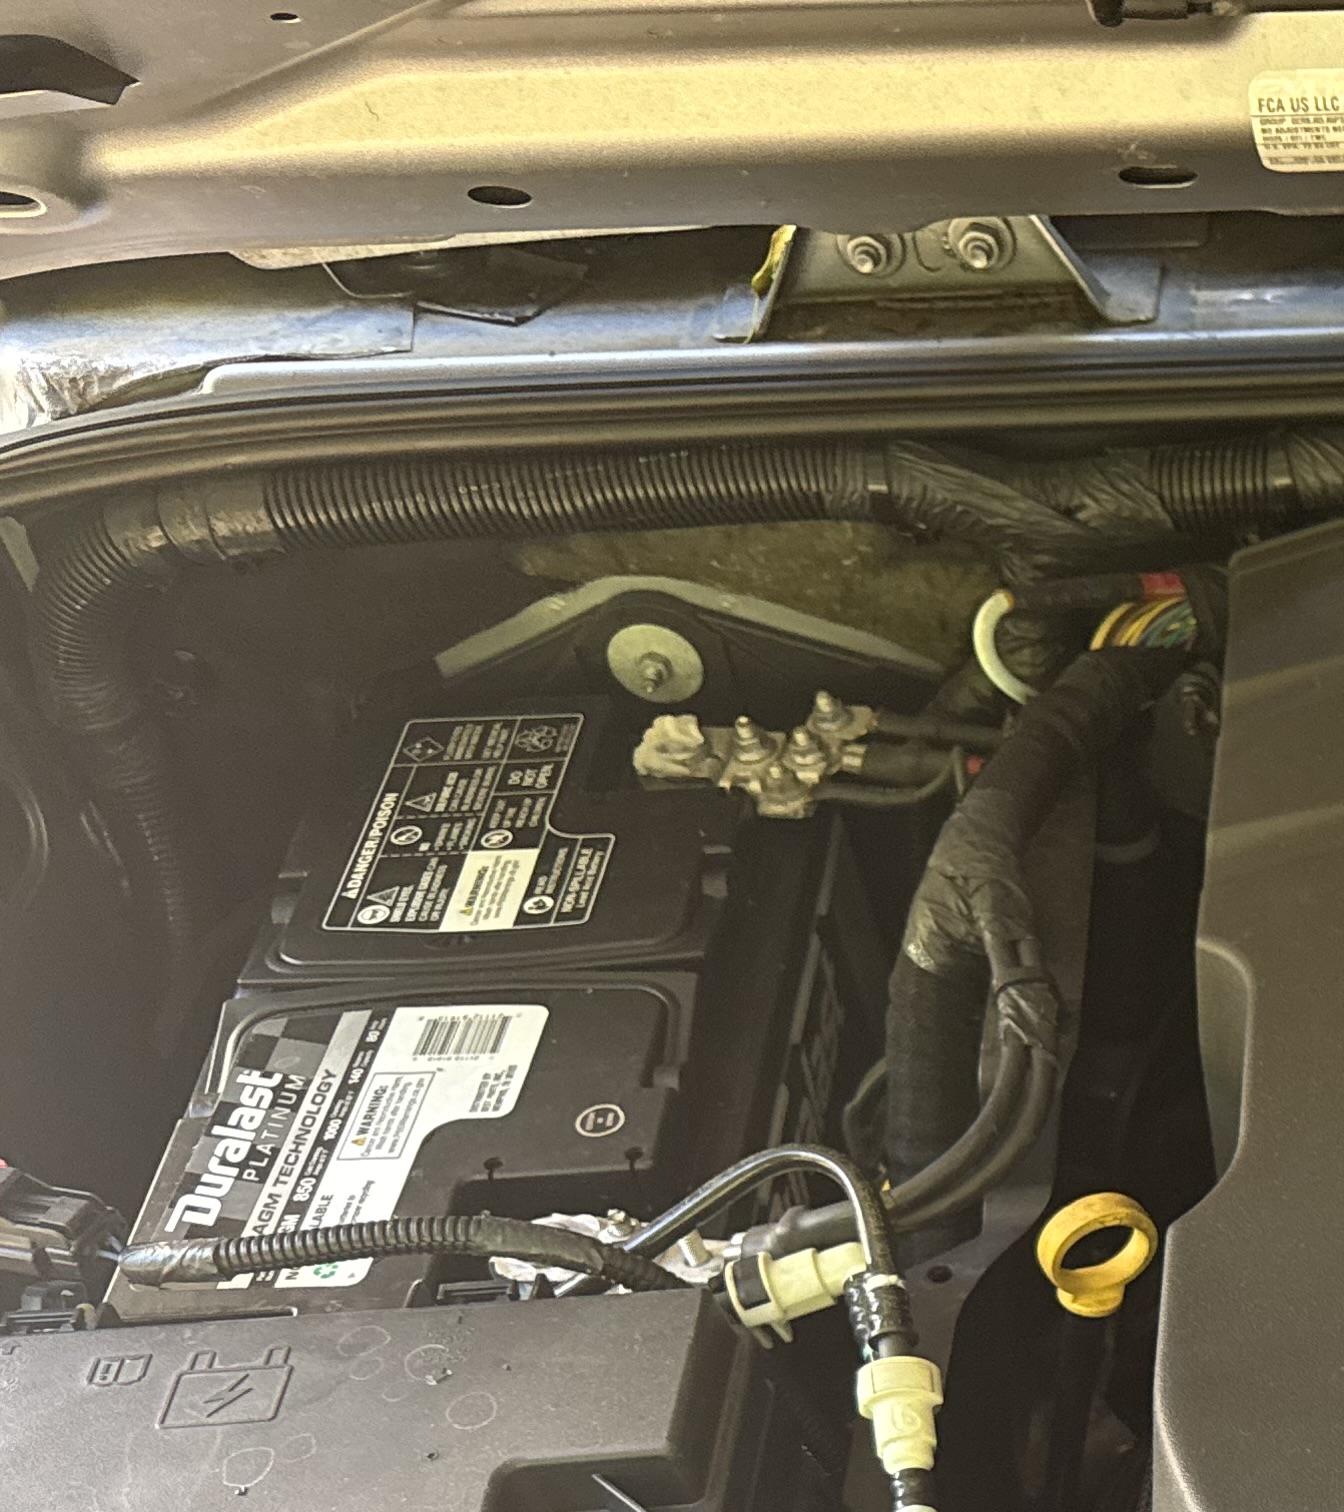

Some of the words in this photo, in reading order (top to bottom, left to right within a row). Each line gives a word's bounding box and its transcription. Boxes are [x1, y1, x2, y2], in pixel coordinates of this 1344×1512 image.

[1257, 97, 1286, 113] FCA
[1289, 97, 1310, 112] US
[1313, 95, 1340, 112] LLC
[350, 792, 400, 888] DANGER/POISON
[347, 1068, 364, 1083] 140
[241, 1074, 307, 1182] PLATINUM
[322, 1118, 342, 1140] 1000
[355, 1085, 388, 1135] WARNING:
[166, 1068, 283, 1233] Duralast
[250, 1192, 283, 1234] AGM
[271, 1068, 339, 1186] TECHNOLOGY
[291, 1177, 317, 1201] 850
